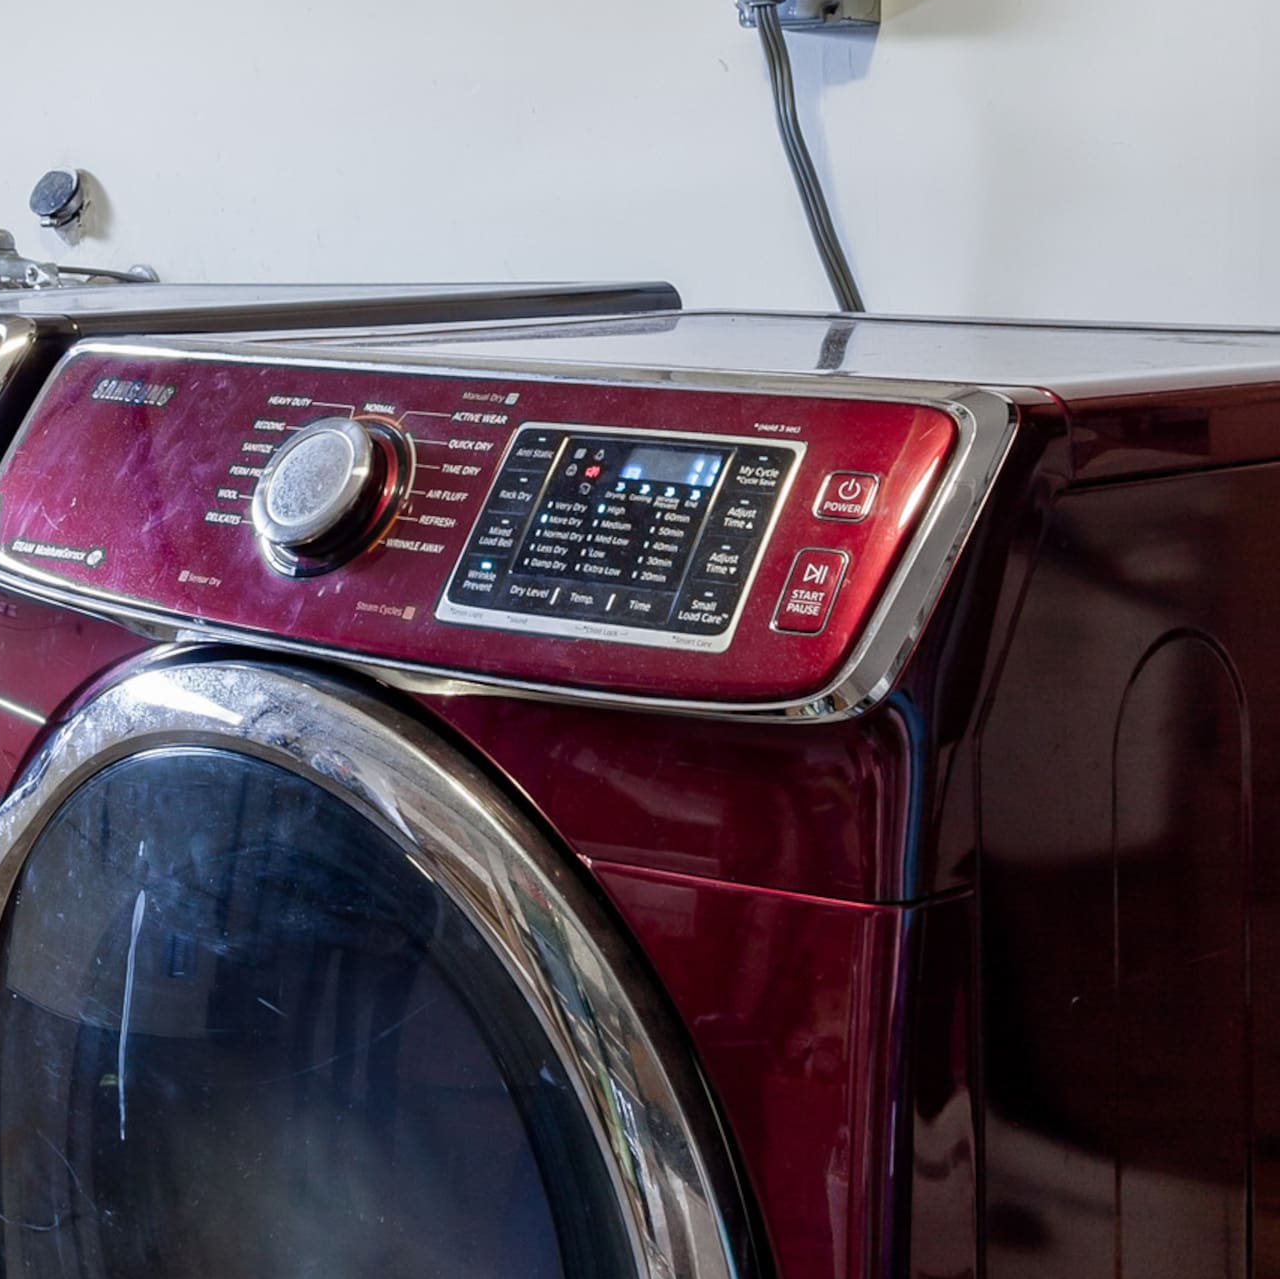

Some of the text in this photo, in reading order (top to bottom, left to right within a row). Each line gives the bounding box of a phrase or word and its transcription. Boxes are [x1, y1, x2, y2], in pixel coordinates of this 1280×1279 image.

[92, 378, 174, 406] SAMSUNG
[462, 391, 505, 404] Manual Dry
[268, 395, 313, 407] HEAVY DUTY
[363, 403, 396, 415] NORMAL
[451, 411, 508, 425] ACTIVE WEAR
[447, 438, 494, 451] QUICK DRY
[533, 449, 554, 460] Static
[229, 465, 249, 476] PERM
[441, 463, 482, 476] TIME DRY
[739, 465, 780, 479] My Cycle
[217, 488, 238, 499] WOOL
[425, 489, 469, 502] AIR FLUFF
[498, 489, 532, 503] Rack Dry
[554, 502, 588, 514] Very Dry
[606, 505, 626, 516] High
[823, 500, 862, 513] POWER
[204, 511, 241, 524] DELICATES
[664, 513, 691, 523] 60min
[727, 506, 758, 520] Adjust
[419, 514, 457, 528] REFRESH
[549, 516, 583, 528] More Dry
[600, 520, 632, 531] Medium
[723, 517, 746, 529] Time
[488, 526, 512, 538] Mixed
[542, 530, 584, 543] Normal Dry
[658, 527, 685, 538] 50min
[386, 538, 445, 554] WRINKLE AWAY
[478, 536, 498, 548] Load
[594, 534, 630, 547] Med Low
[536, 543, 568, 556] Less Dry
[652, 542, 679, 553] 40min
[646, 556, 673, 567] 30min
[709, 552, 740, 565] Adjust
[531, 559, 567, 571] Damp Dry
[583, 563, 622, 577] Extra Low
[706, 563, 729, 575] Time
[467, 570, 497, 582] Wrinkle
[640, 571, 668, 583] 20min
[462, 581, 494, 593] Prevent
[509, 584, 550, 599] Dry Level
[569, 592, 594, 606] Temp.
[791, 589, 825, 601] START
[355, 600, 403, 618] Steam Cycles
[629, 599, 652, 613] Time
[691, 599, 718, 611] Small
[786, 603, 821, 616] PAUSE
[677, 610, 700, 623] Load
[696, 639, 713, 649] Care
